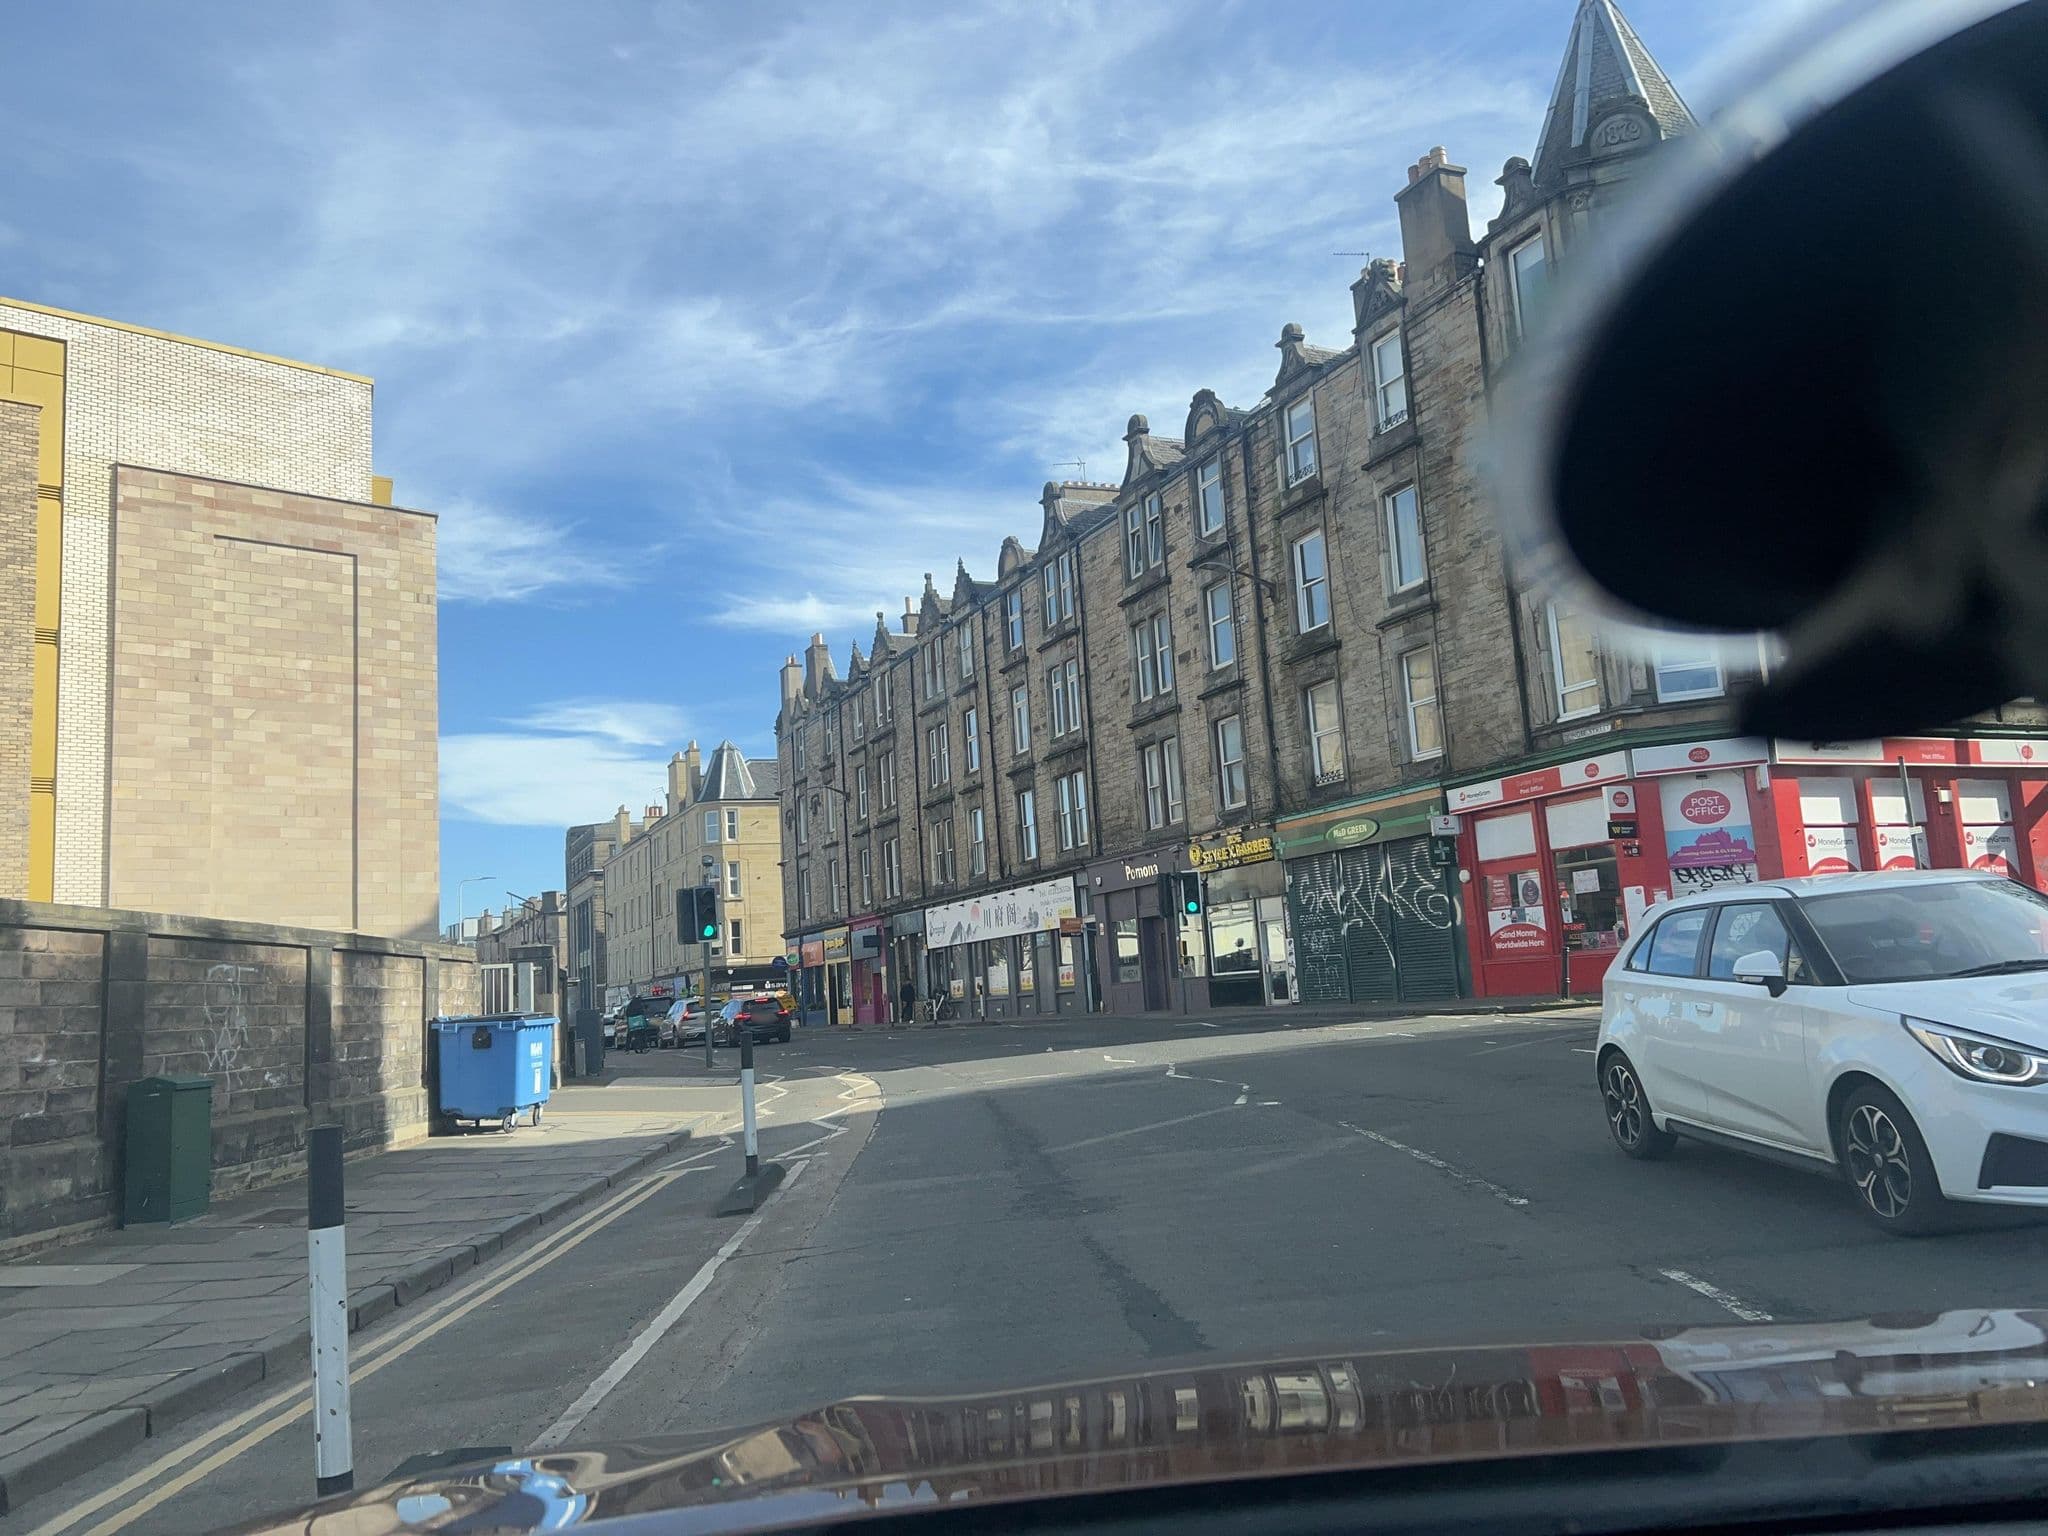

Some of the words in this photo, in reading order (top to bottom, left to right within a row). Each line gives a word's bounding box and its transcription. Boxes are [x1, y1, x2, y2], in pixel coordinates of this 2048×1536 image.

[1690, 796, 1720, 806] POST
[1685, 805, 1726, 817] OFFICE
[1347, 824, 1368, 835] GREEN
[1817, 837, 1854, 846] MoneyGram
[1888, 836, 1922, 846] MoneyGm
[1976, 833, 2011, 844] MoneyGram
[1236, 838, 1272, 856] BARBER
[1125, 864, 1159, 881] Pomona
[1500, 931, 1515, 939] Send
[1516, 929, 1537, 939] Money
[1495, 940, 1528, 949] Worldwide
[1529, 938, 1545, 947] Here
